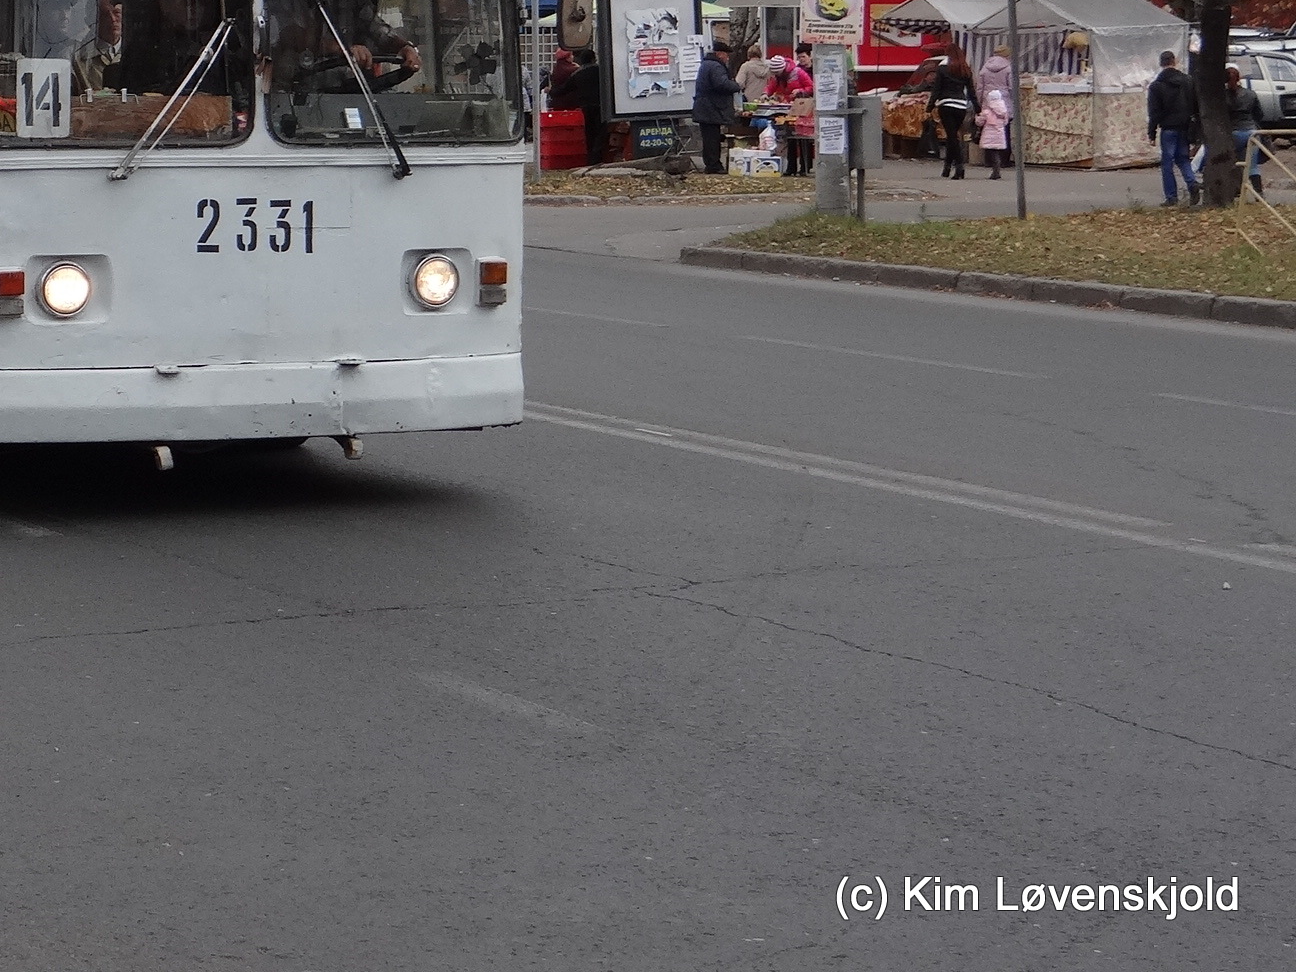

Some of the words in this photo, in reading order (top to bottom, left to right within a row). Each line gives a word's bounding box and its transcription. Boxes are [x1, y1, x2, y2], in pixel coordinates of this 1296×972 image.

[20, 72, 62, 128] 14
[639, 127, 673, 137] АРЕНДА
[196, 197, 314, 254] 2331
